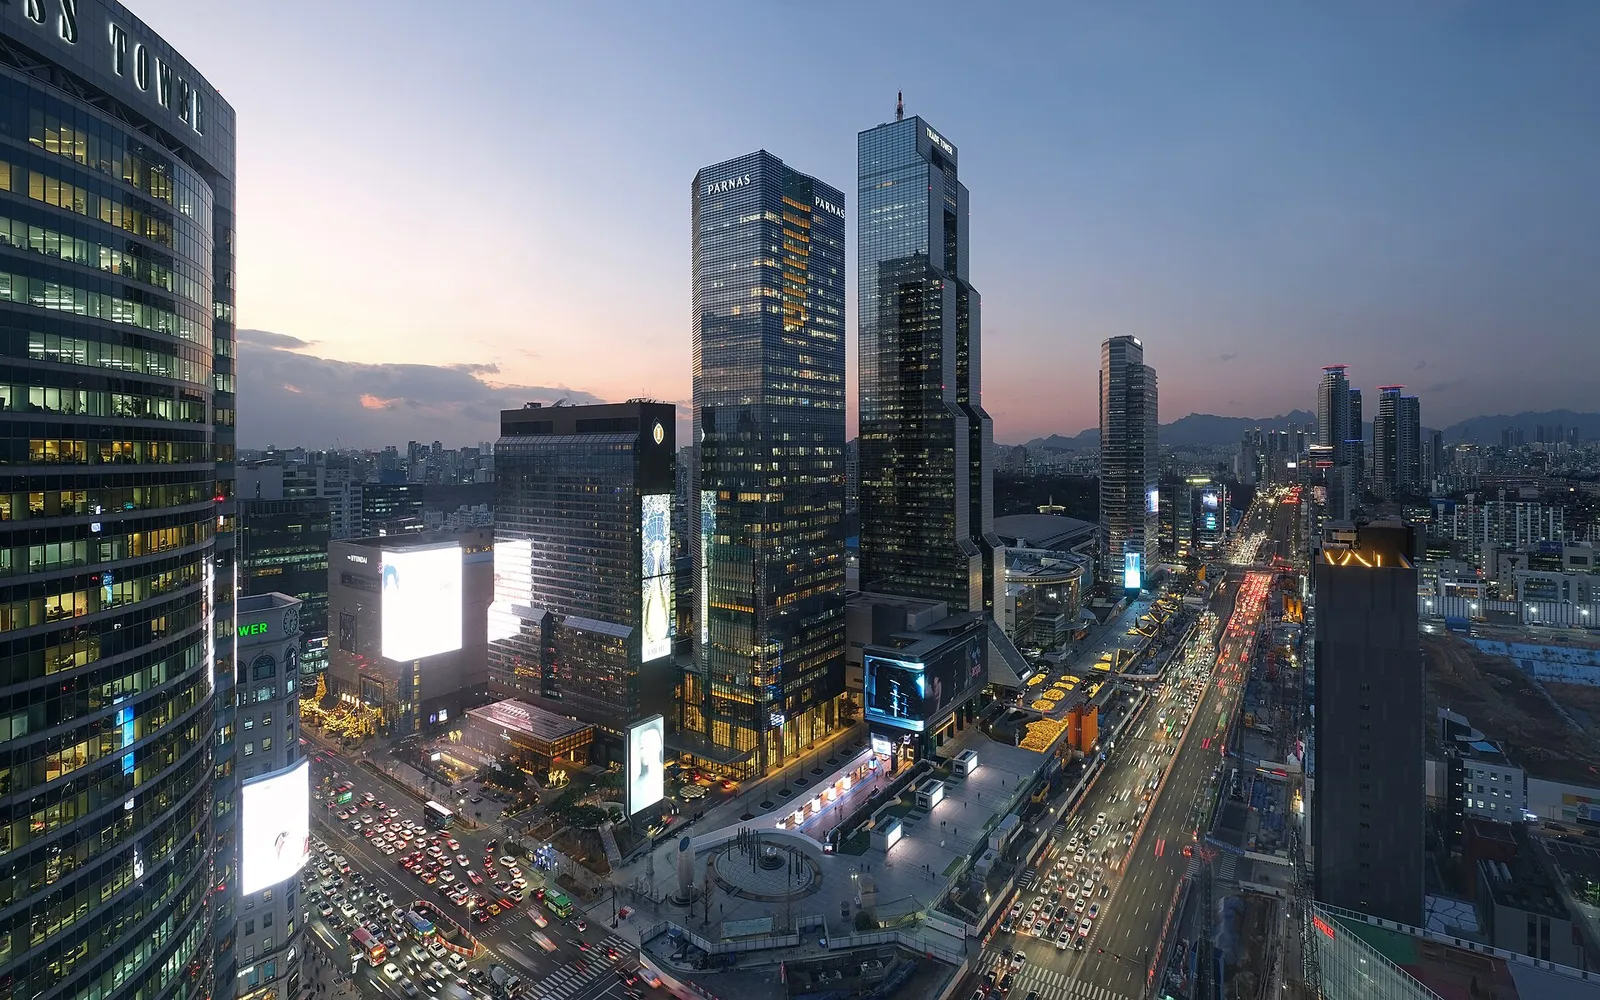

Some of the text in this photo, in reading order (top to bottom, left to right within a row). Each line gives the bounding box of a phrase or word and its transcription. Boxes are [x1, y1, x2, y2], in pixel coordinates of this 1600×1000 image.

[108, 22, 204, 137] TOWER
[707, 173, 751, 195] PARNAS
[815, 196, 845, 219] PARNAS
[238, 622, 268, 637] WER
